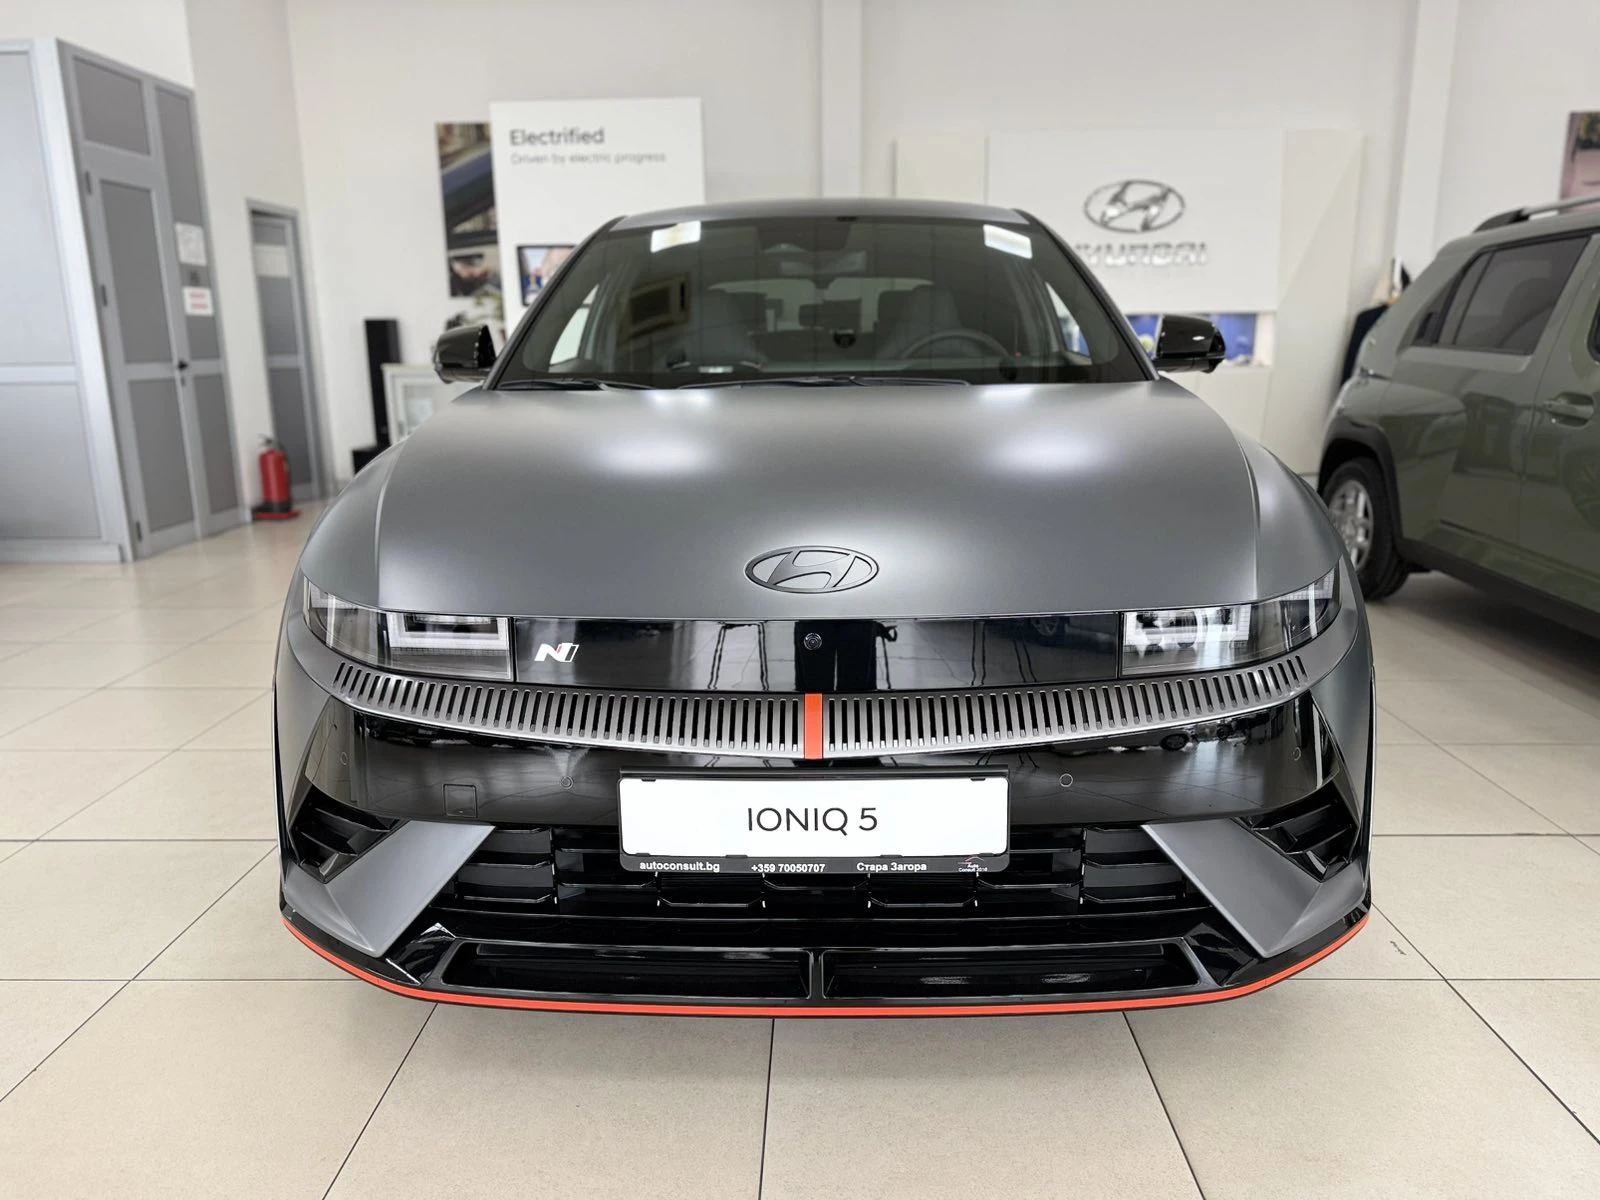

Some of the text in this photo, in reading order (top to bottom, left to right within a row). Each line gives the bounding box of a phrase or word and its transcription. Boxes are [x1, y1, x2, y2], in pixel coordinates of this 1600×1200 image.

[509, 127, 606, 146] Electrified
[511, 152, 667, 166] Driven by electric progress
[748, 807, 878, 836] IONIQ 5
[639, 861, 720, 873] autoconsult.bg
[751, 863, 826, 873] +359 70050707
[856, 862, 927, 872] Стара Загора
